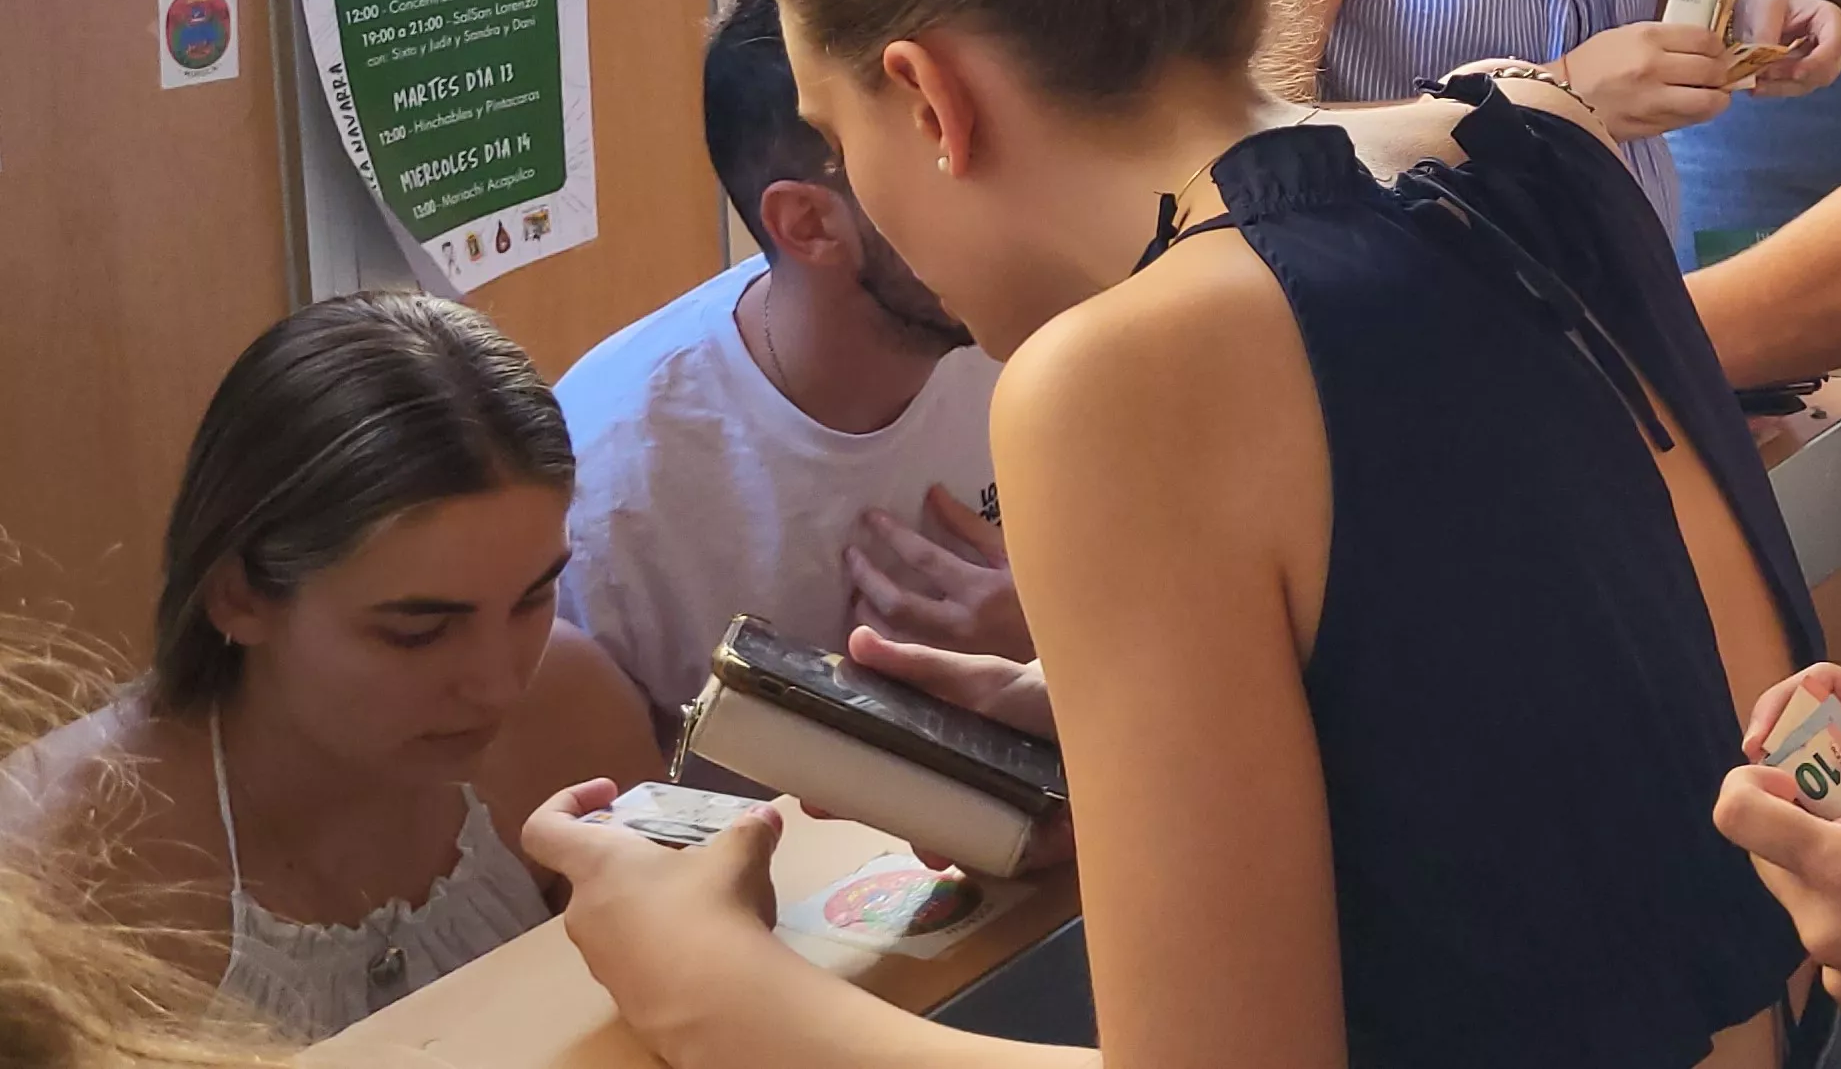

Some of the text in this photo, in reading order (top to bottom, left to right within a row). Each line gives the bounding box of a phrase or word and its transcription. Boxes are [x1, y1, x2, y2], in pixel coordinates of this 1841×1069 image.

[345, 4, 379, 26] 12:00
[362, 27, 396, 48] 19:00
[398, 27, 407, 38] a
[409, 14, 444, 34] 21:00
[420, 43, 426, 57] y
[455, 33, 461, 48] y
[464, 24, 501, 43] Sandra
[503, 23, 510, 37] y
[512, 14, 537, 31] Dani
[328, 62, 365, 153] NAVARRA
[393, 75, 460, 113] MARTES
[500, 62, 514, 83] 13
[379, 90, 541, 147] 12:00 Hinchables y Pintacaras
[400, 147, 479, 193] MIERCOLES
[517, 132, 531, 154] 14
[488, 166, 536, 192] Acapulco
[1795, 752, 1841, 801] 10
